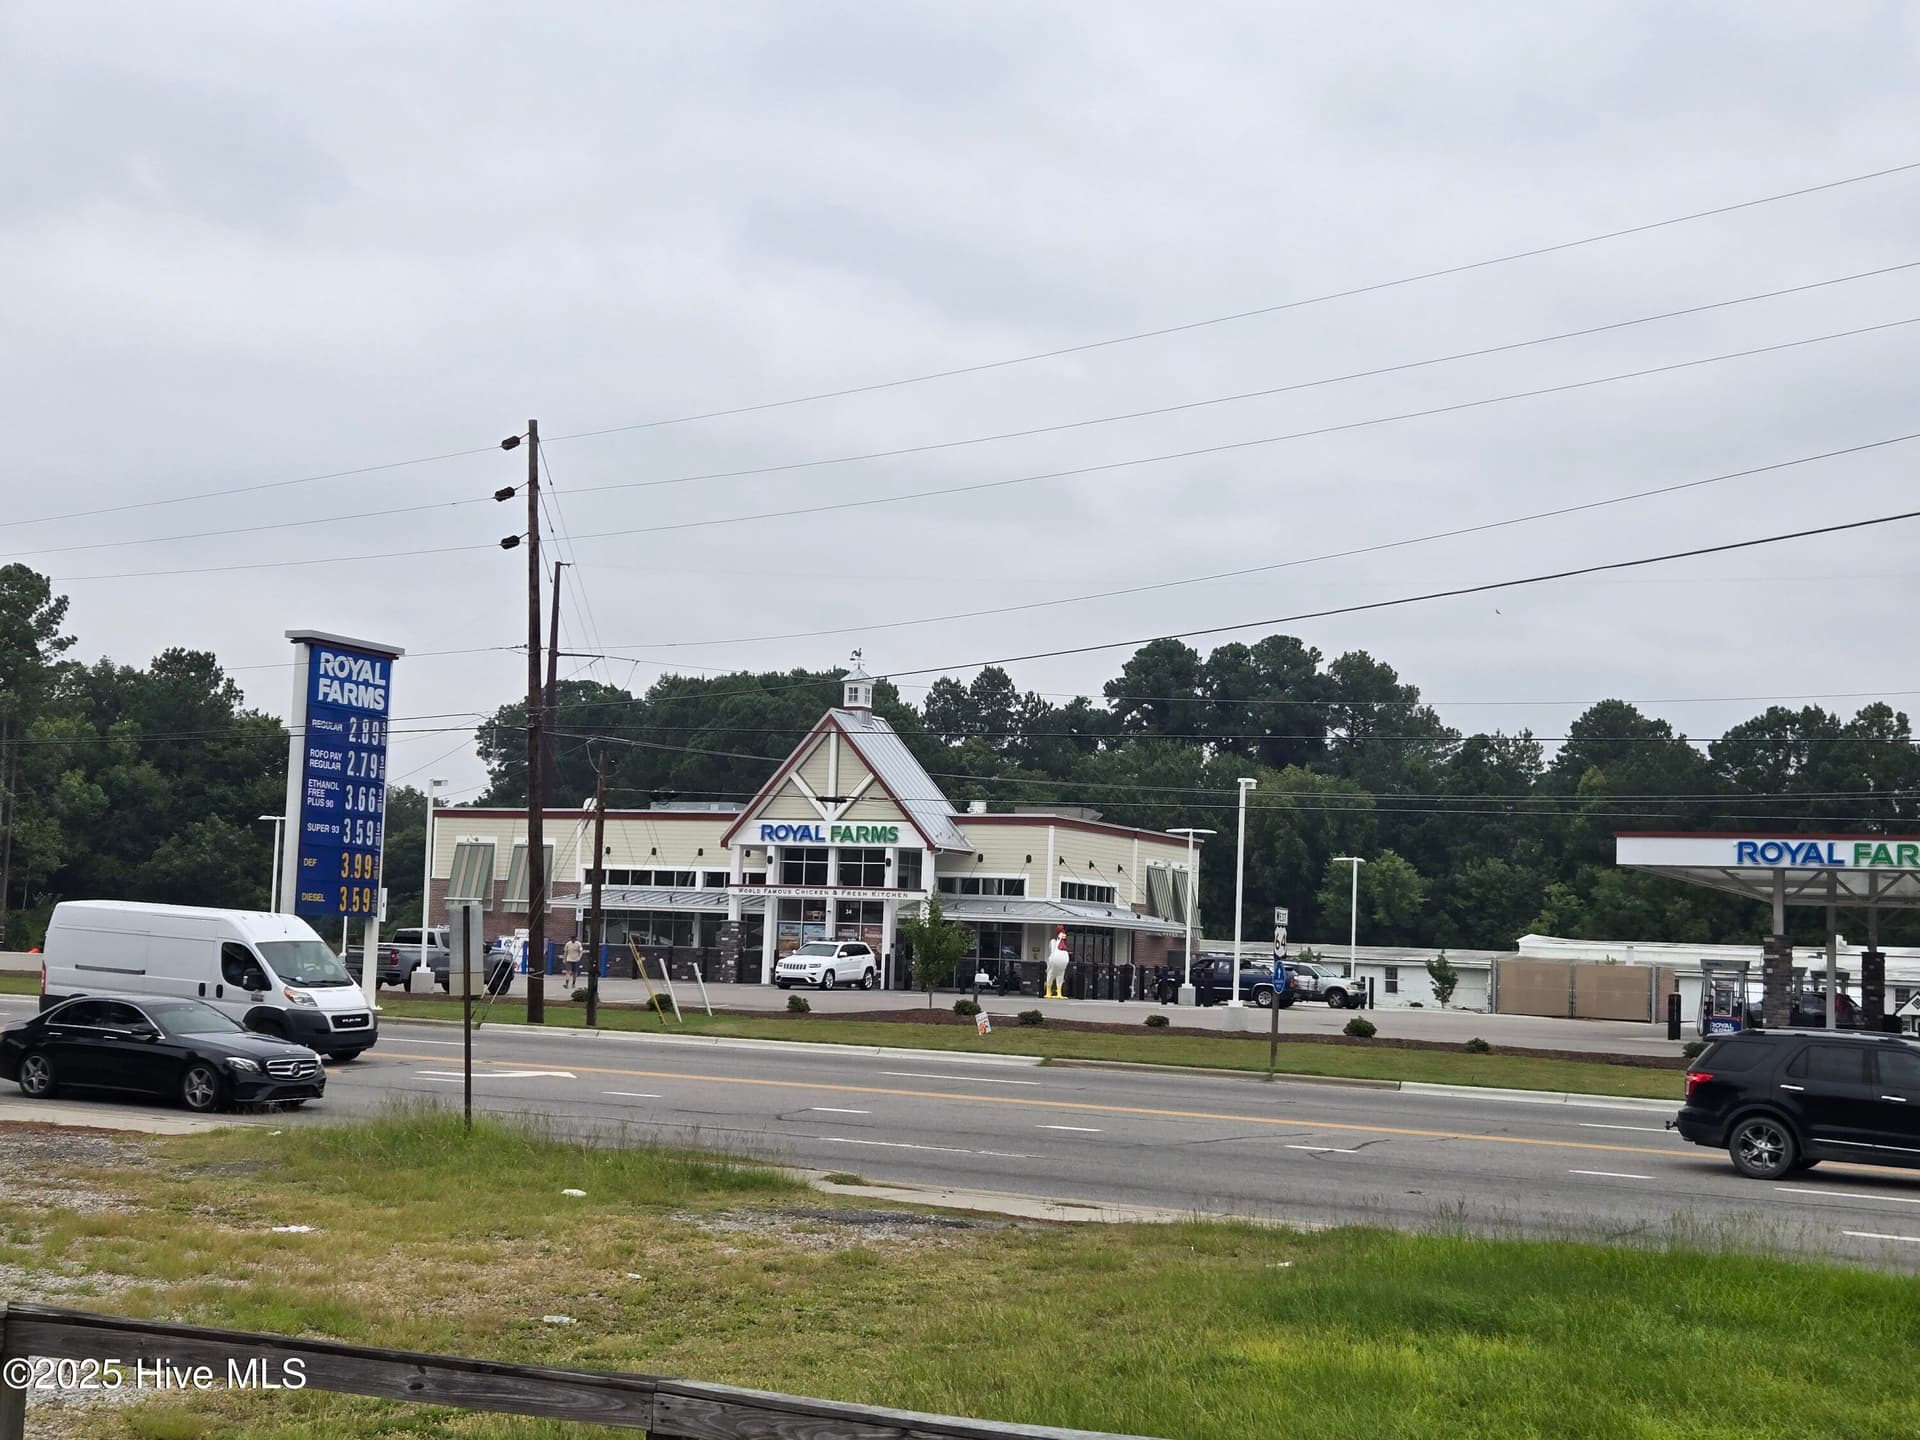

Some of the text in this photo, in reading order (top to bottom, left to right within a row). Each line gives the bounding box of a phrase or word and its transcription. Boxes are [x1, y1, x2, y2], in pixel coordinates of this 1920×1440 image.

[319, 652, 386, 686] ROYAL
[318, 677, 385, 710] FARMS
[311, 719, 343, 732] REGULAR
[349, 717, 379, 745] 2.89
[309, 749, 342, 760] ROFO PAY
[309, 759, 341, 771] REGULAR
[347, 750, 378, 778] 2.79
[307, 788, 326, 797] FREE
[308, 779, 340, 791] ETHANOL
[307, 797, 334, 808] PLUS 90
[345, 785, 376, 812] 3.66
[307, 823, 330, 833] SUPER
[331, 825, 340, 834] 93
[343, 818, 374, 846] 3.59
[760, 824, 899, 844] ROYAL FARMS
[303, 857, 318, 867] DEF
[341, 852, 372, 879] 3.99
[1736, 841, 1845, 866] ROYAL
[301, 892, 325, 902] DIESEL
[339, 886, 371, 912] 3.59
[1275, 932, 1287, 951] 64
